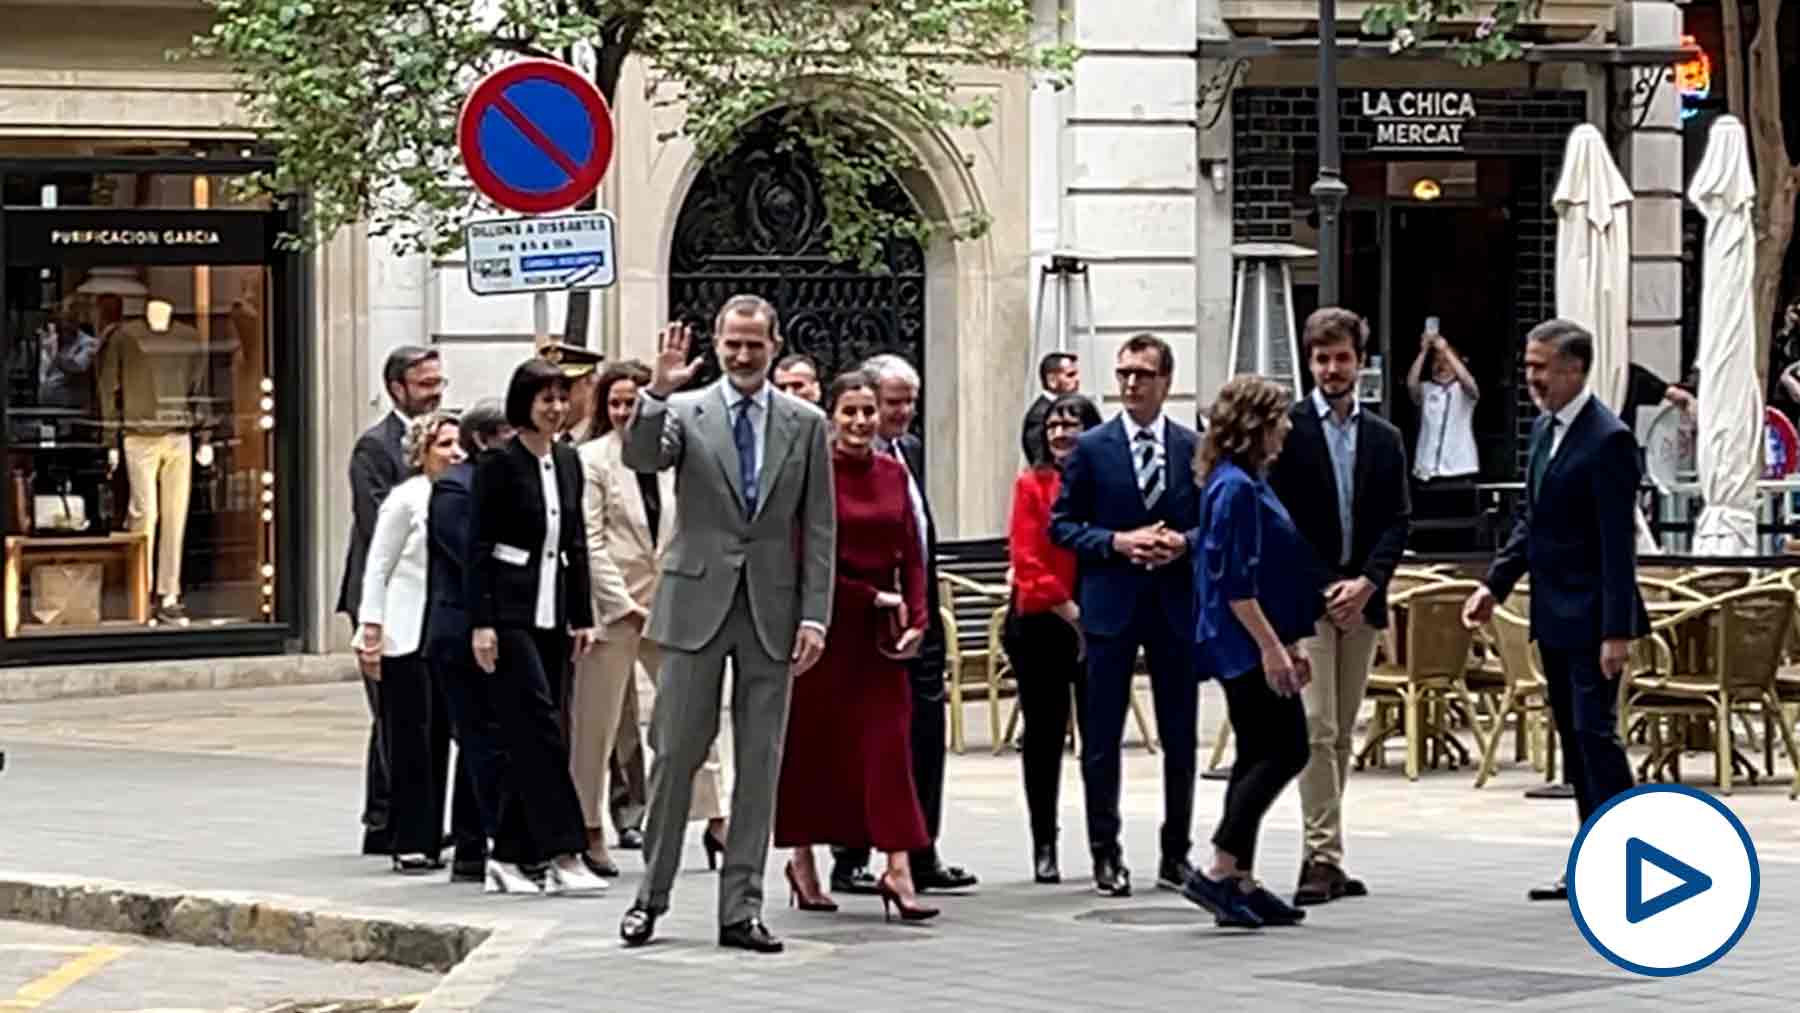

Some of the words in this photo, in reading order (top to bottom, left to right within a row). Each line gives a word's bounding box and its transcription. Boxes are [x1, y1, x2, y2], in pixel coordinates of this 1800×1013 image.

[1362, 91, 1394, 115] LA
[1398, 92, 1476, 117] CHICA
[1377, 123, 1462, 144] MERCAT
[163, 229, 220, 245] GARCIA
